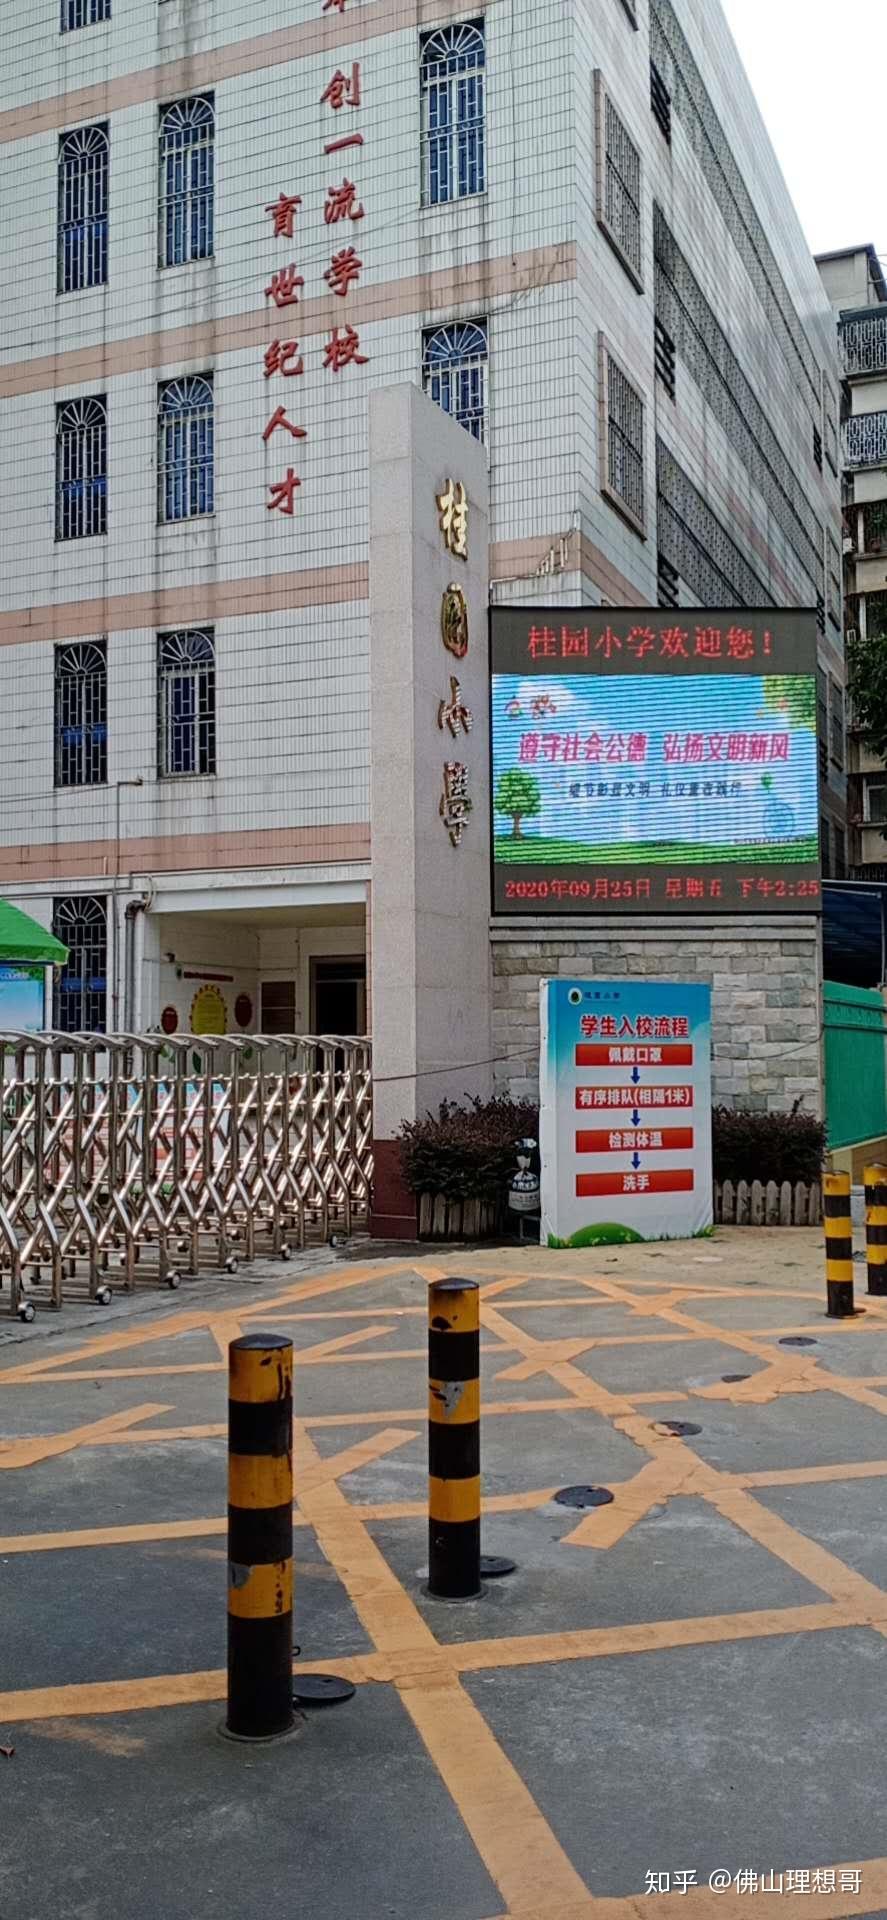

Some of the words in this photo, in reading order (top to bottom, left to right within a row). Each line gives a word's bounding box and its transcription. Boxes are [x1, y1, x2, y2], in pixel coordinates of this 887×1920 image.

[321, 0, 369, 374] 创一流学校
[263, 192, 307, 515] 育世纪人才
[518, 732, 648, 763] 遵守社会公德
[662, 731, 791, 763] 弘扬文明新风
[505, 878, 651, 899] 2020年09月25日
[736, 877, 820, 898] 下午2:25
[581, 1015, 689, 1038] 学生入校流程
[608, 1047, 663, 1063] 佩戴口罩
[579, 1087, 690, 1106] 有序排队(相隔1米)
[608, 1132, 663, 1148] 检测体温
[623, 1174, 650, 1191] 洗手
